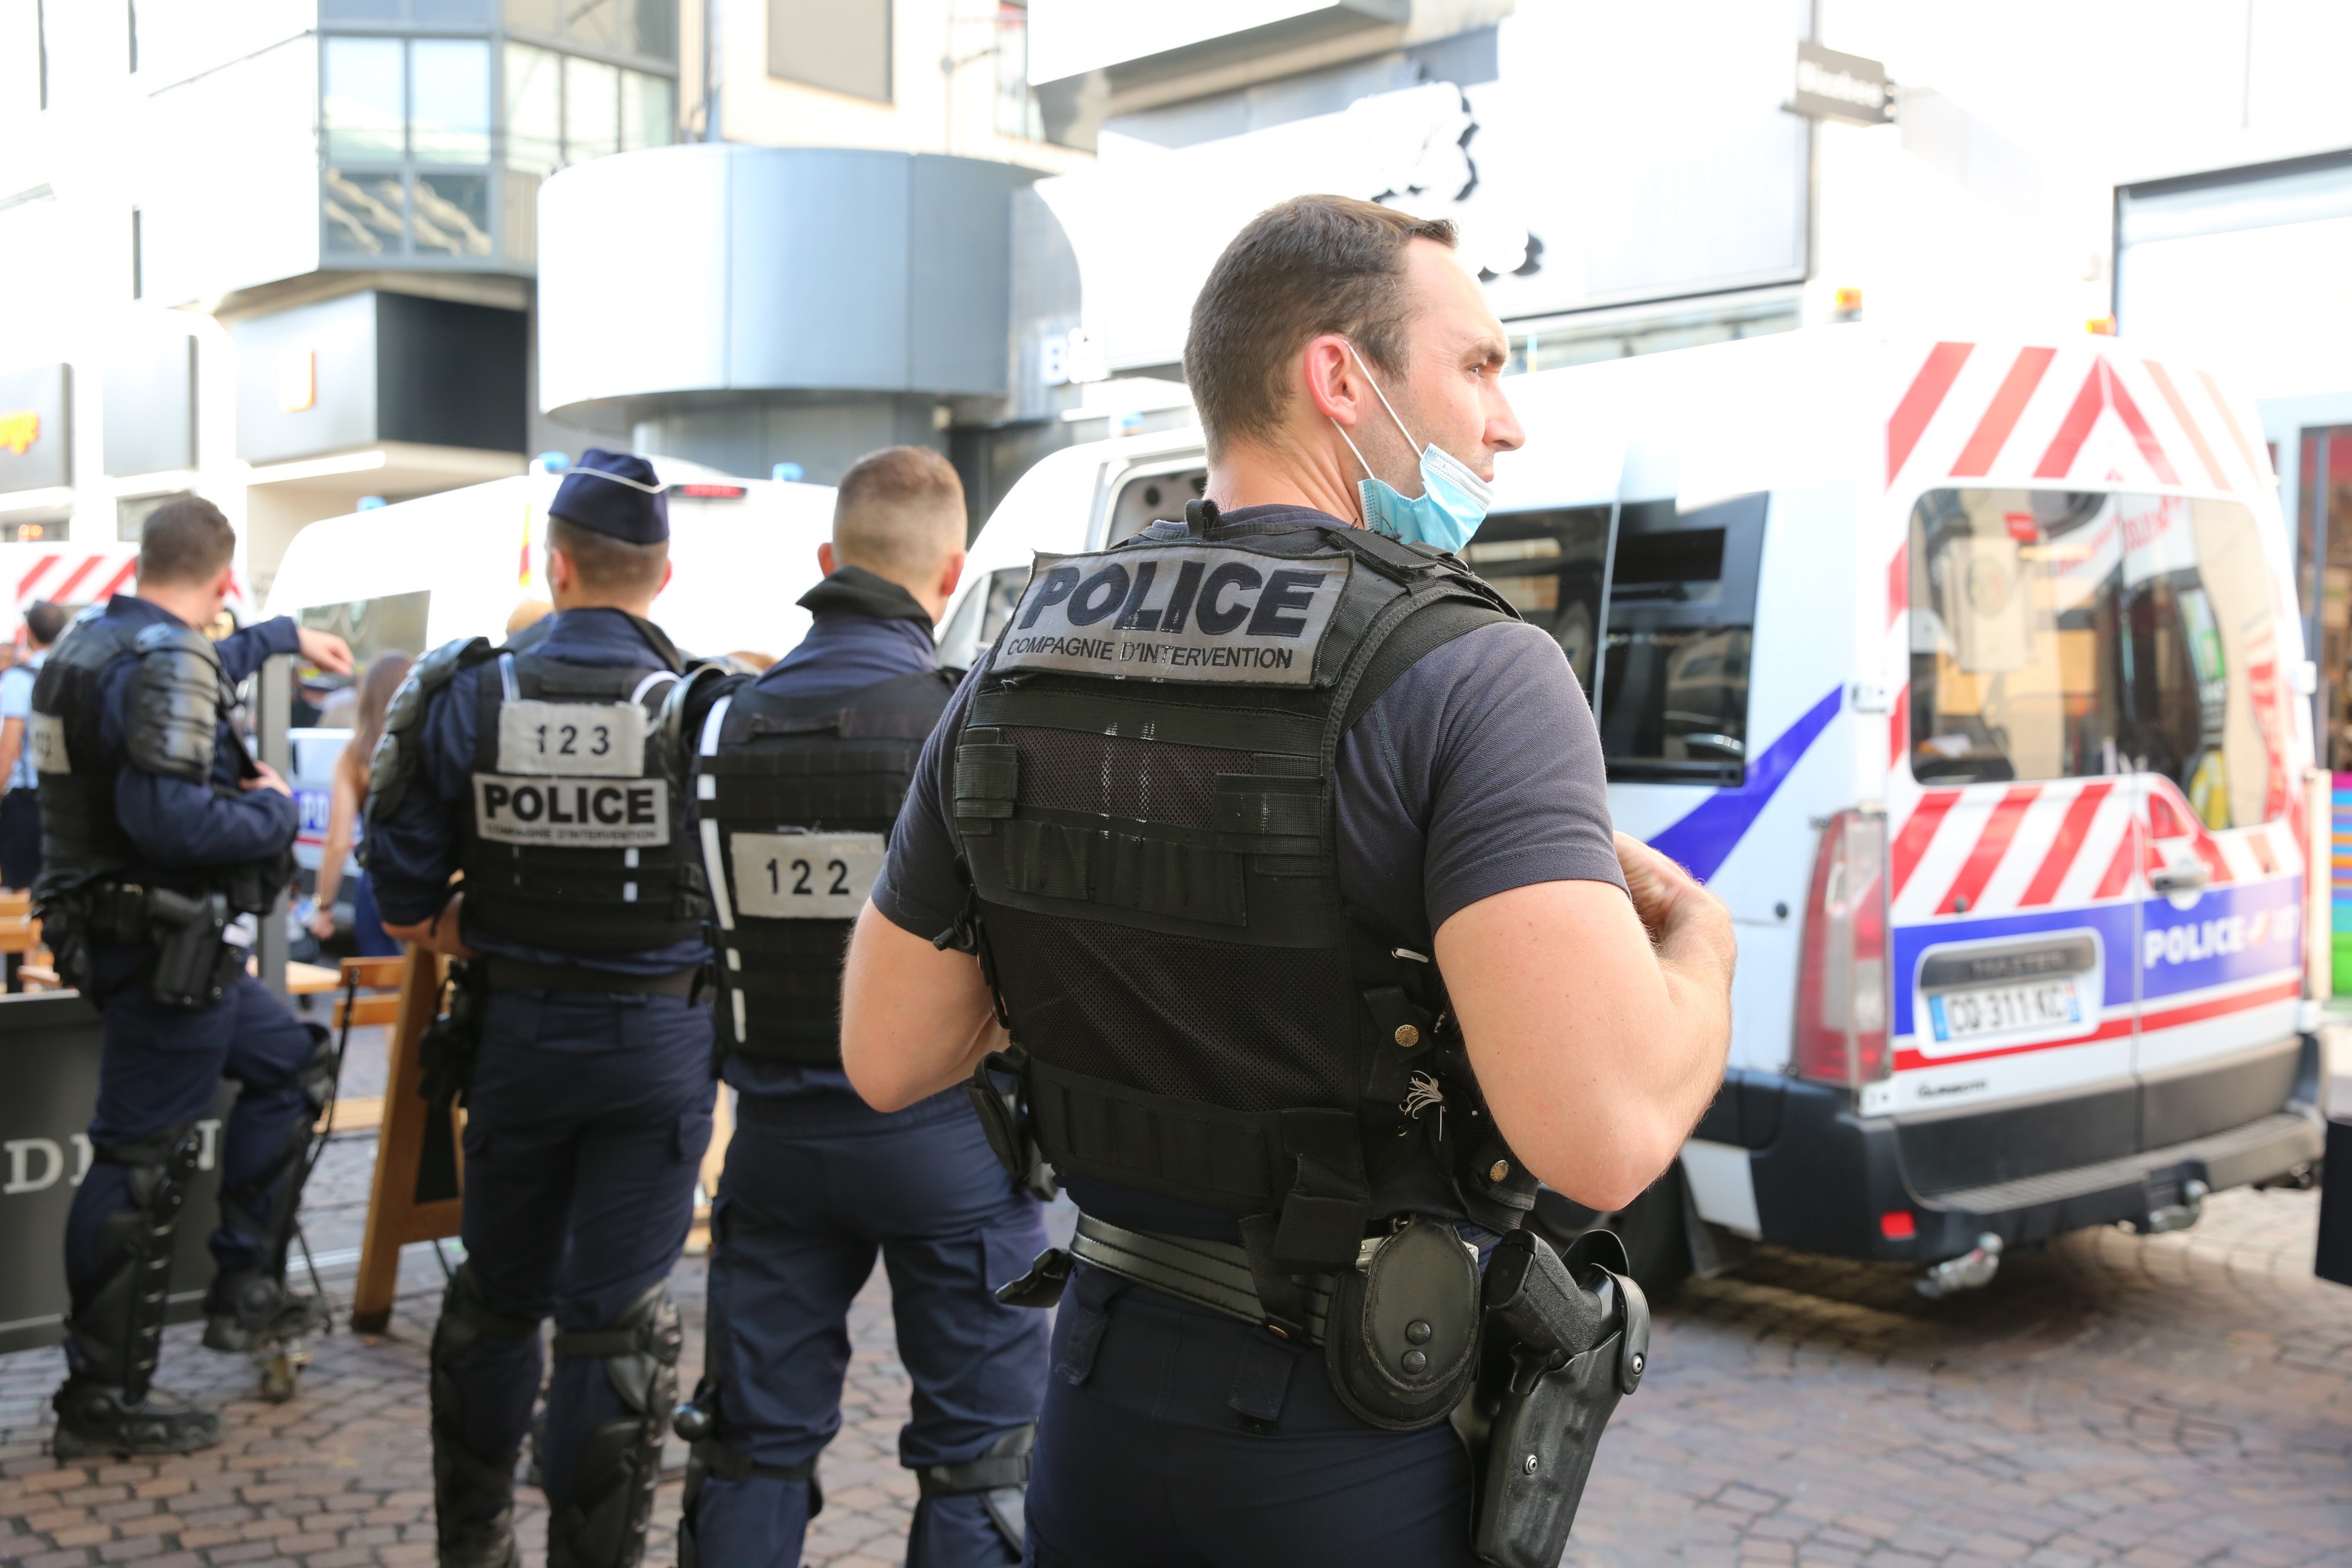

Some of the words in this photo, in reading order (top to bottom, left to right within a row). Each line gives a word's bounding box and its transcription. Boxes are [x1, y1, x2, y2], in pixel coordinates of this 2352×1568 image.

[1018, 560, 1327, 638] POLICE
[1007, 637, 1113, 661] COMPAGNIE
[1119, 642, 1294, 669] D'INTERVENTION
[536, 724, 610, 755] 123
[484, 784, 655, 824] POLICE
[766, 858, 850, 895] 122
[2144, 915, 2246, 969] POLICE
